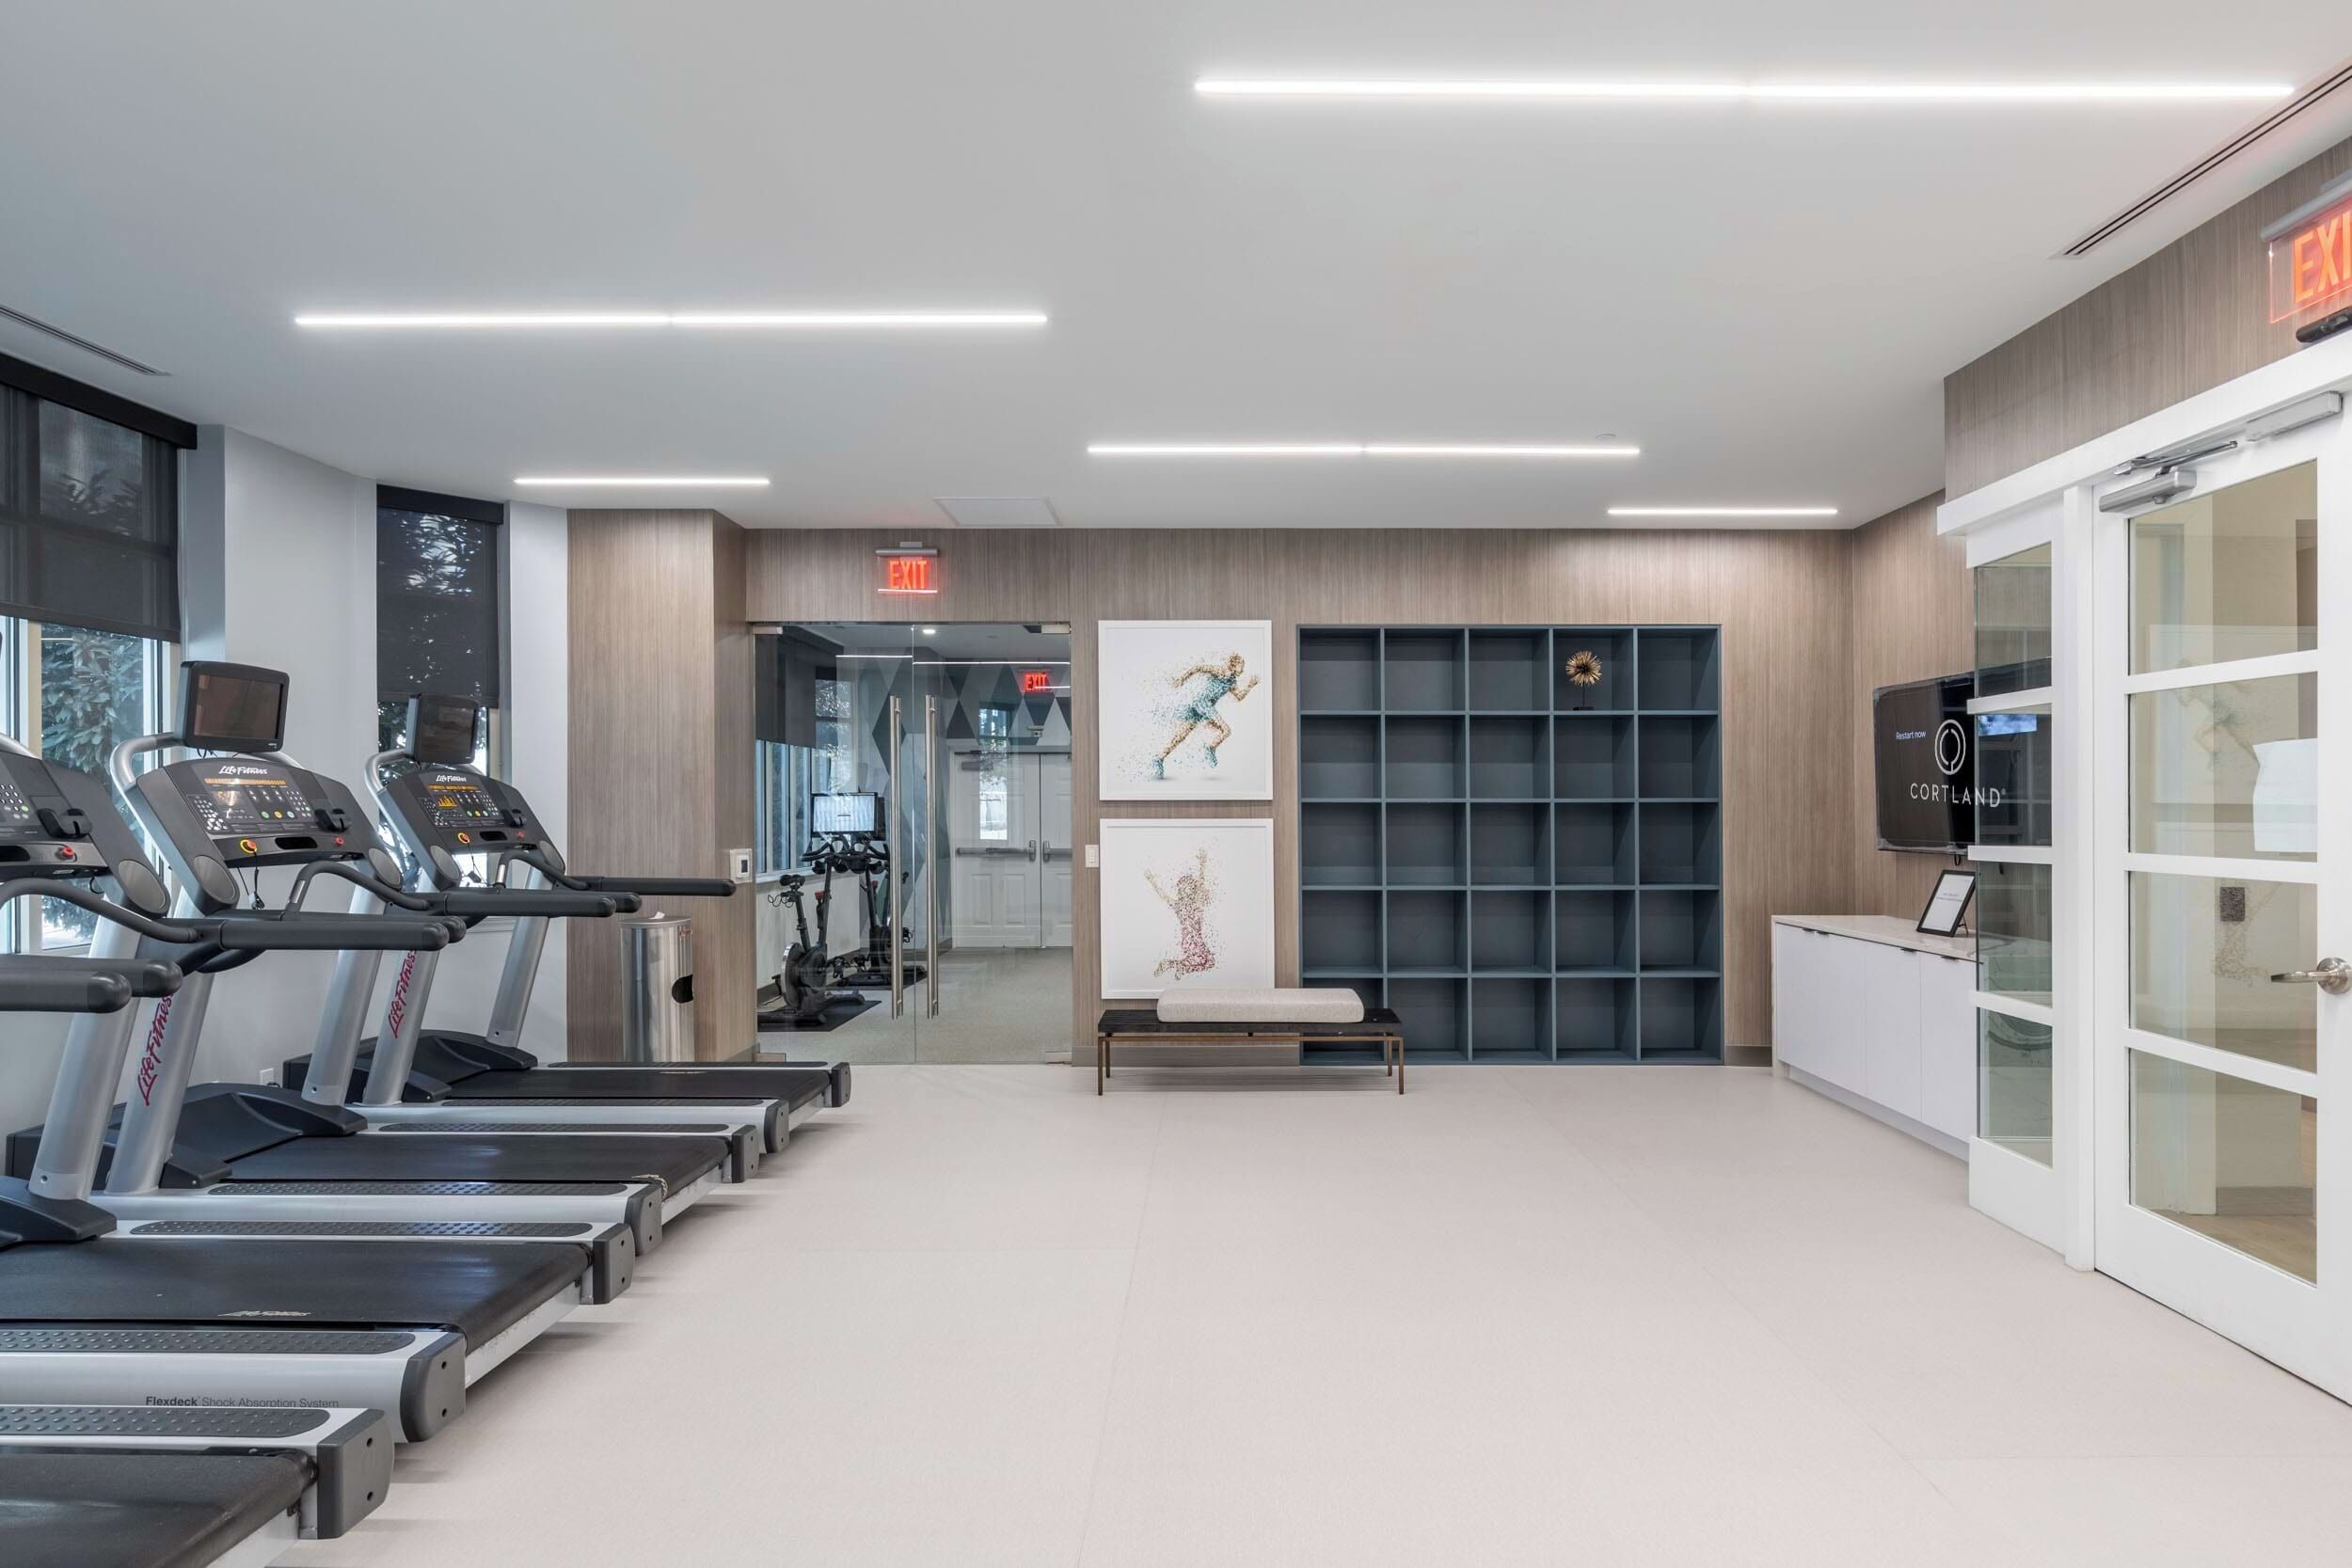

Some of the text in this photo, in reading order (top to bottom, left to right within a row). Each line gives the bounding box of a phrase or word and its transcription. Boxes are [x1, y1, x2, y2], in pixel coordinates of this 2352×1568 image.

[2294, 209, 2352, 304] EXI
[889, 561, 928, 589] EXIT
[1025, 673, 1047, 691] EXIT
[1896, 731, 1914, 739] Restart
[1910, 783, 2001, 807] CORTLAND
[146, 993, 174, 1064] Fitnes
[145, 1396, 340, 1408] Flexdeck Shock Absorption System
